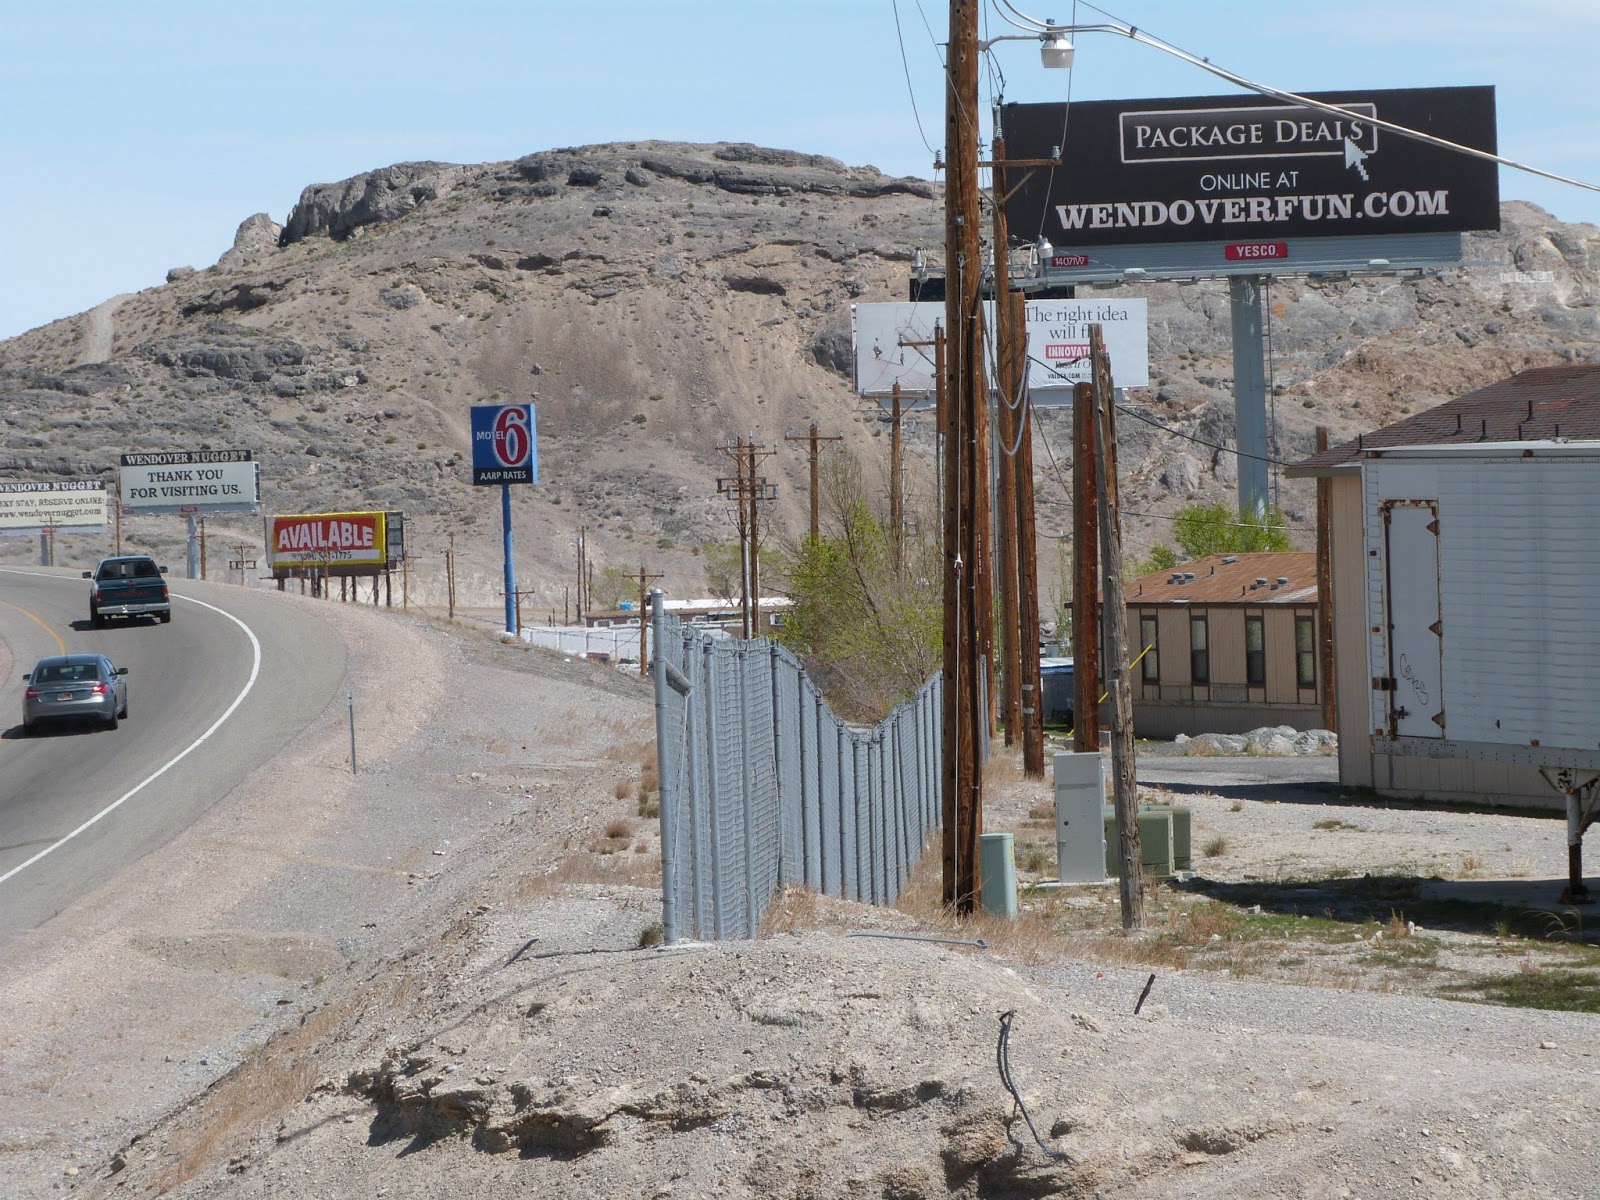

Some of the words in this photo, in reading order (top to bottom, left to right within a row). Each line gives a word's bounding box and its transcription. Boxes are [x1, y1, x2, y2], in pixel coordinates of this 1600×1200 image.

[1134, 124, 1264, 149] PACKAGE
[1274, 119, 1364, 143] DEALS
[1200, 172, 1271, 190] ONLINE
[1276, 171, 1299, 188] AT
[1055, 189, 1450, 229] WENDOVERFUN.COM
[1026, 305, 1052, 321] The
[1056, 305, 1093, 325] right
[1097, 305, 1129, 321] idea
[1049, 324, 1076, 339] will
[1048, 346, 1091, 358] INNOVATI
[476, 430, 506, 440] MOTEL
[494, 407, 528, 467] 6
[125, 452, 188, 466] WENDOVER
[190, 449, 247, 463] NUGGET
[147, 470, 193, 483] THANK
[196, 469, 224, 481] YOU
[480, 472, 501, 480] AARP
[503, 471, 526, 479] RATES
[52, 480, 102, 491] NUGGET
[130, 487, 158, 499] FOR
[161, 485, 218, 498] VISITING
[221, 483, 242, 495] US.
[15, 499, 37, 508] STAY,
[38, 497, 74, 507] RESERVE
[75, 497, 105, 505] ONLINE:
[278, 520, 373, 549] AVAILABLE
